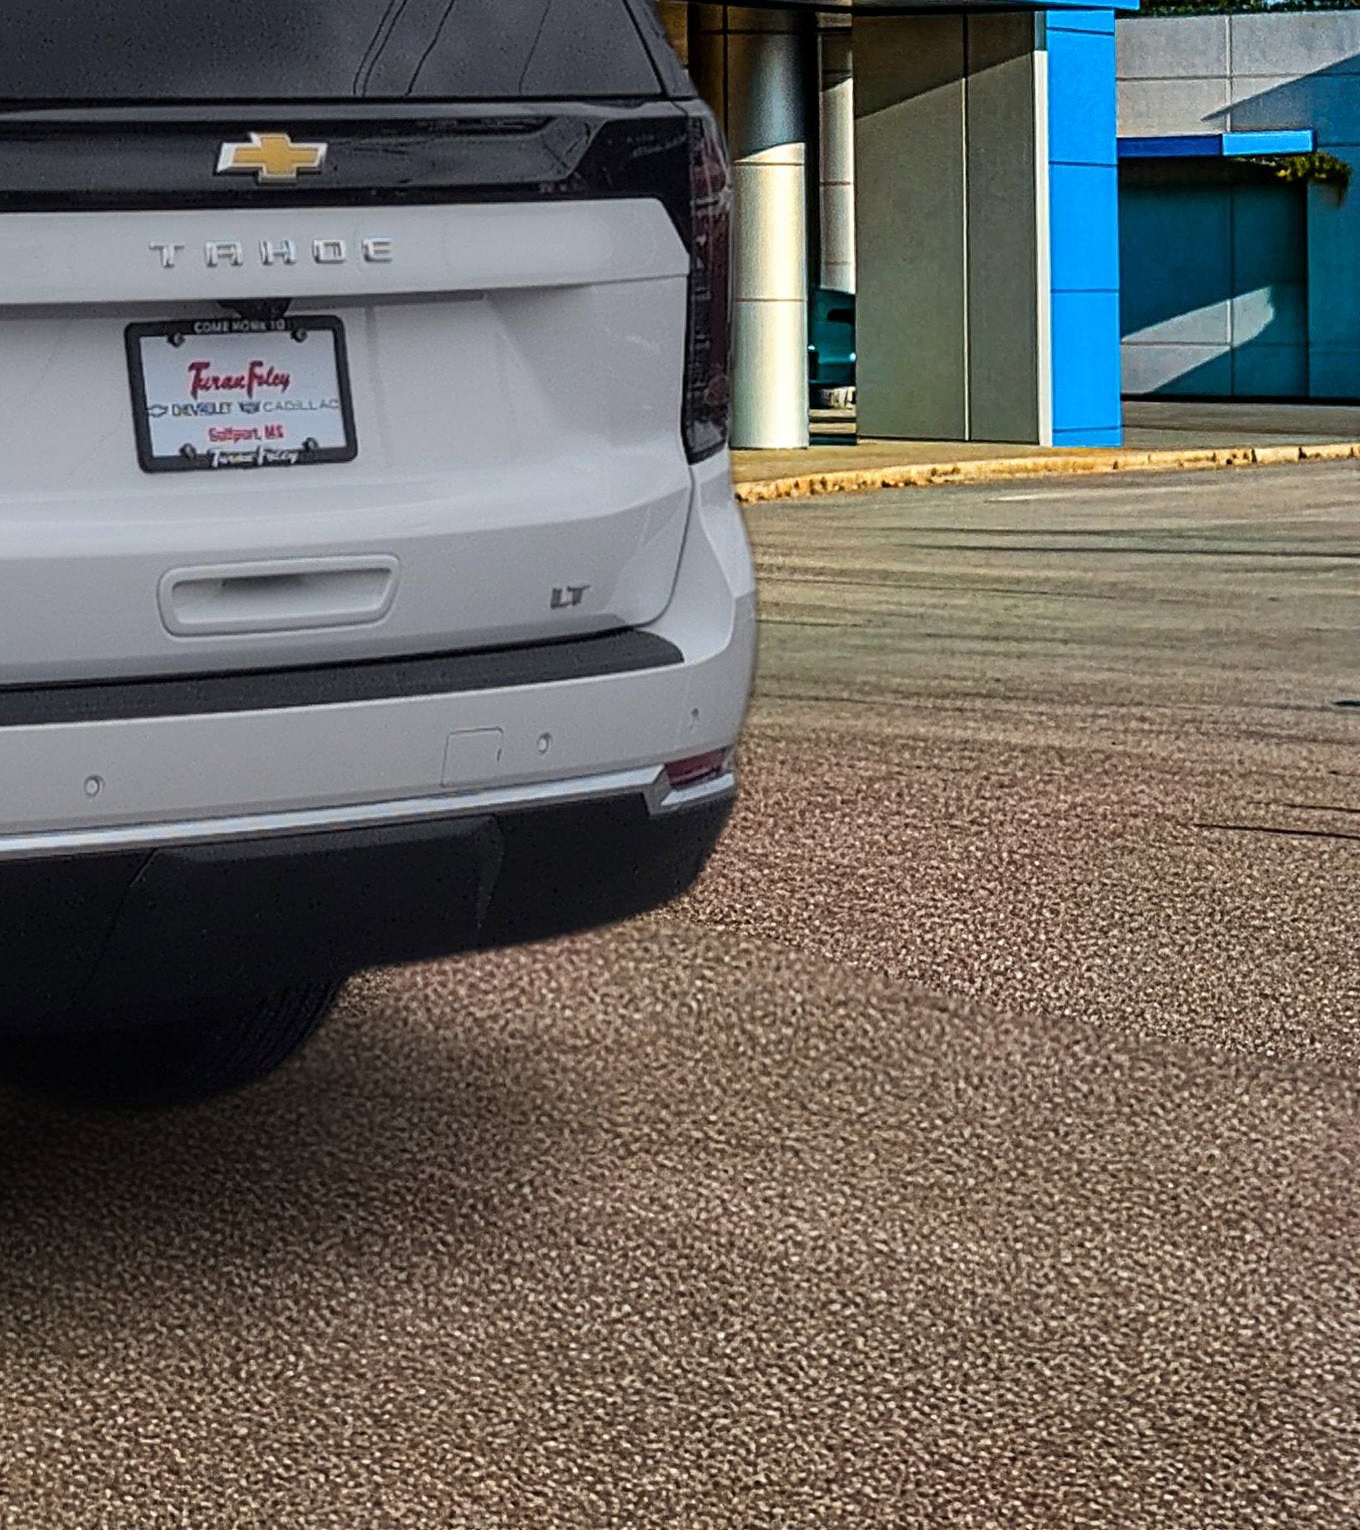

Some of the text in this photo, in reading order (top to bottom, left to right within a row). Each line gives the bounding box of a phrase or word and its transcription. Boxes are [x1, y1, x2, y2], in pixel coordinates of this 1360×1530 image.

[148, 237, 394, 268] TAHOE
[262, 398, 340, 413] CADILLAC
[550, 584, 591, 609] LT
